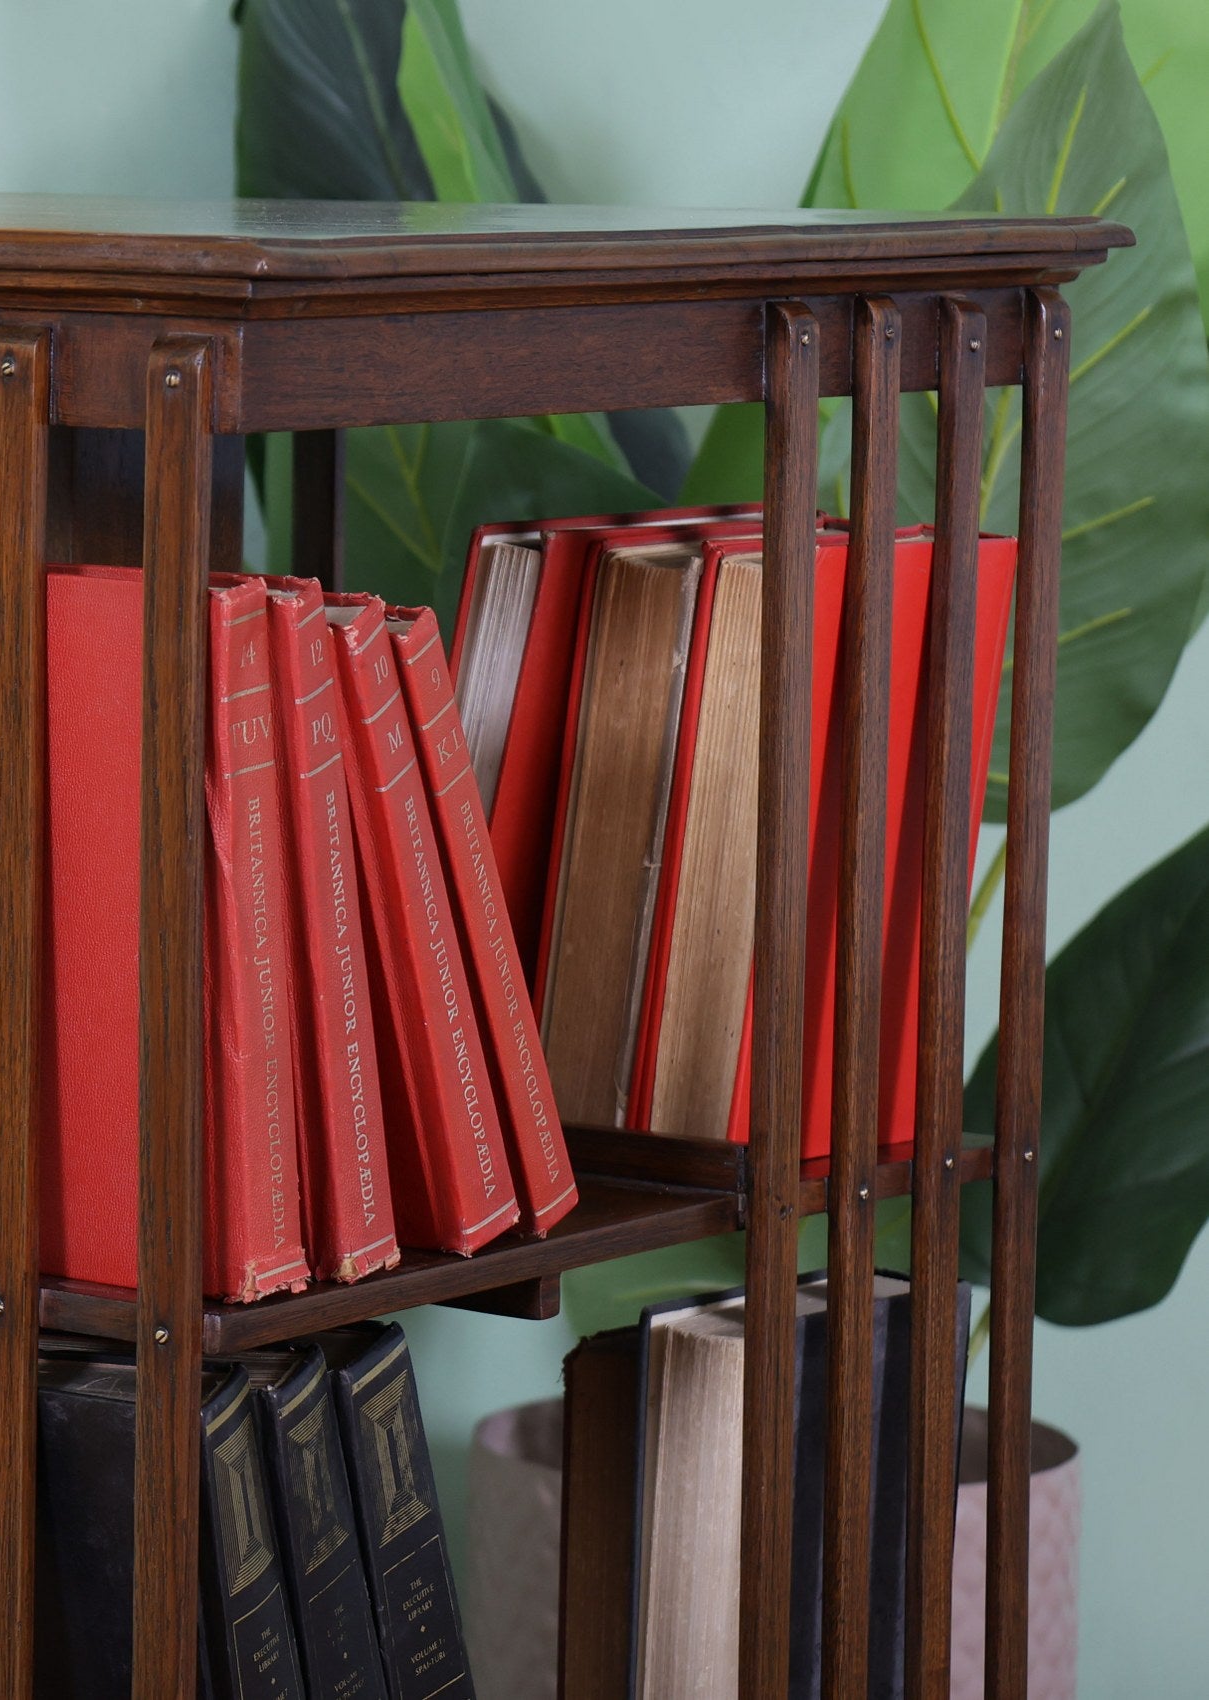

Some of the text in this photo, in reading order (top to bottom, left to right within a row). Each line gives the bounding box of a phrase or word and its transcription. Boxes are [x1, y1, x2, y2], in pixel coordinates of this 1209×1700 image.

[240, 640, 256, 669] 14
[310, 638, 324, 667] 12
[373, 655, 389, 685] 10
[431, 668, 441, 691] 9
[311, 712, 336, 746] PQ
[386, 722, 404, 754] M
[248, 796, 268, 949] BRITANNICA
[325, 789, 350, 940] BRITANNICA
[404, 795, 439, 935] BRITANNICA
[430, 938, 459, 1024] JUNIOR
[460, 800, 497, 934] BRITANNICA
[489, 935, 520, 1018] JUNIOR
[254, 956, 276, 1047] JUNIOR
[336, 945, 357, 1035] JUNIOR
[409, 1576, 423, 1591] THE
[253, 1633, 281, 1662] EXECUTIVE
[260, 1626, 273, 1642] THE
[258, 1651, 280, 1673] LIBRARY
